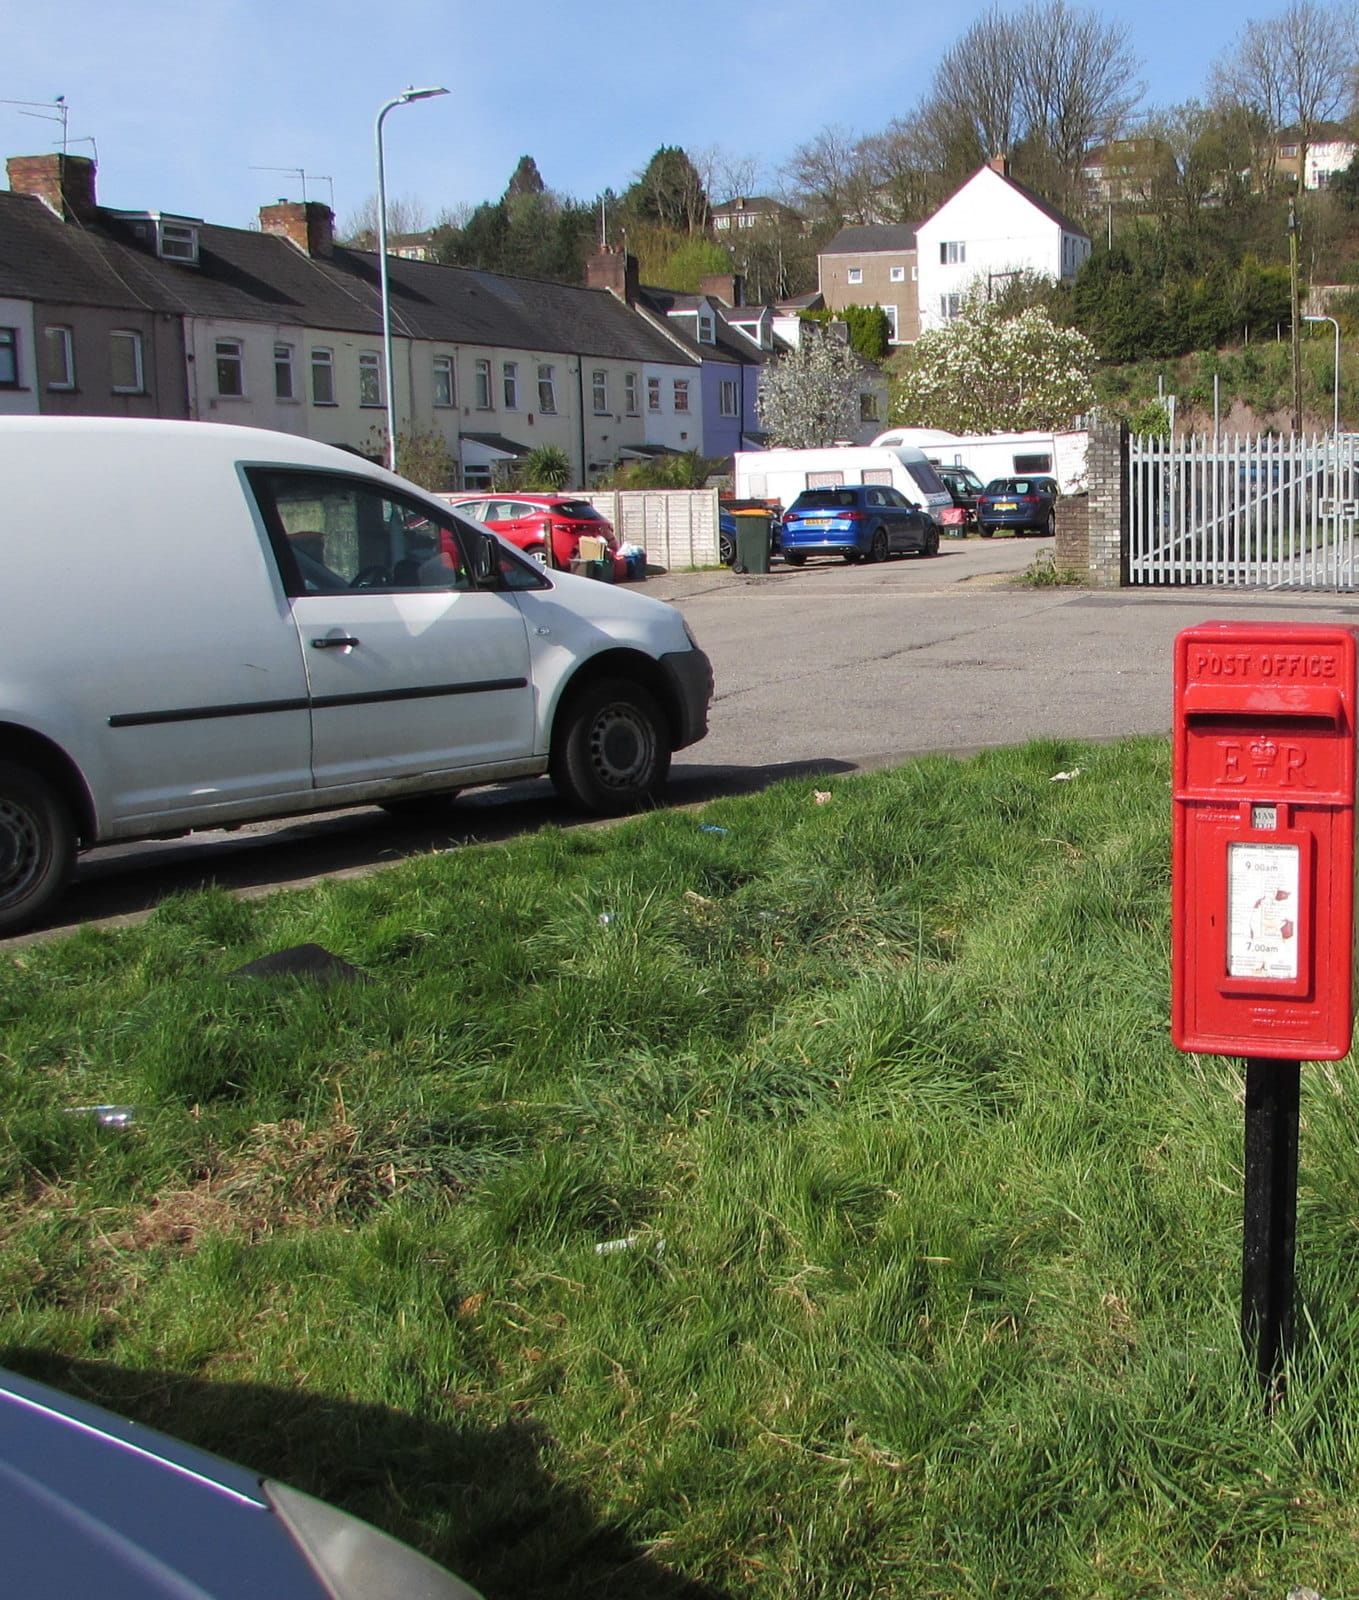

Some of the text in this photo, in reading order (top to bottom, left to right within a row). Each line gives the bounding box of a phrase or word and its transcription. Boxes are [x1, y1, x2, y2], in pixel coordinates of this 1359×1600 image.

[1196, 654, 1336, 678] POST OFFICE
[1215, 741, 1317, 788] E R
